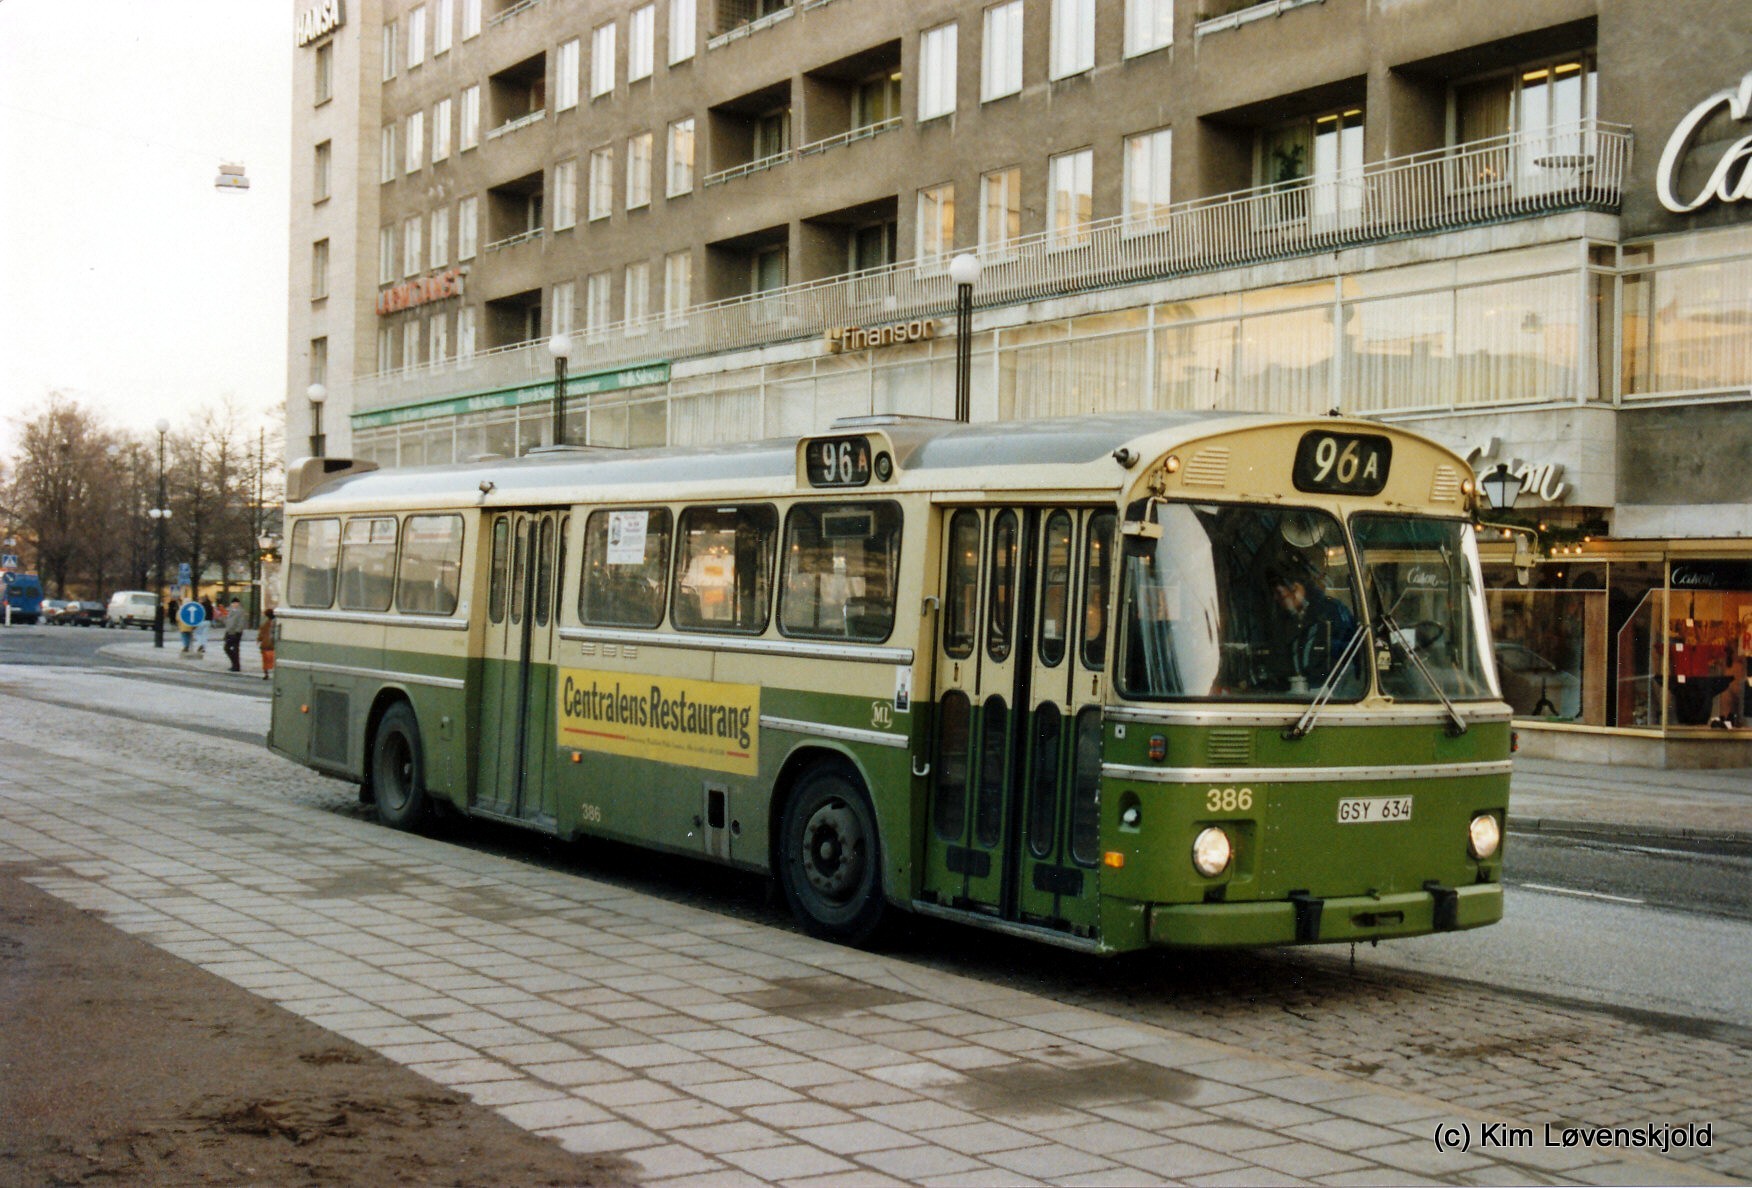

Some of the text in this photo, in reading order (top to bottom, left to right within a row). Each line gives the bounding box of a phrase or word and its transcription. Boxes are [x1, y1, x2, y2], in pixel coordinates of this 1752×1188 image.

[294, 0, 340, 47] HANSA
[564, 675, 752, 750] Centralens Restaurang
[1205, 787, 1253, 812] 386
[1339, 800, 1410, 821] GSY 634
[581, 802, 602, 823] 386
